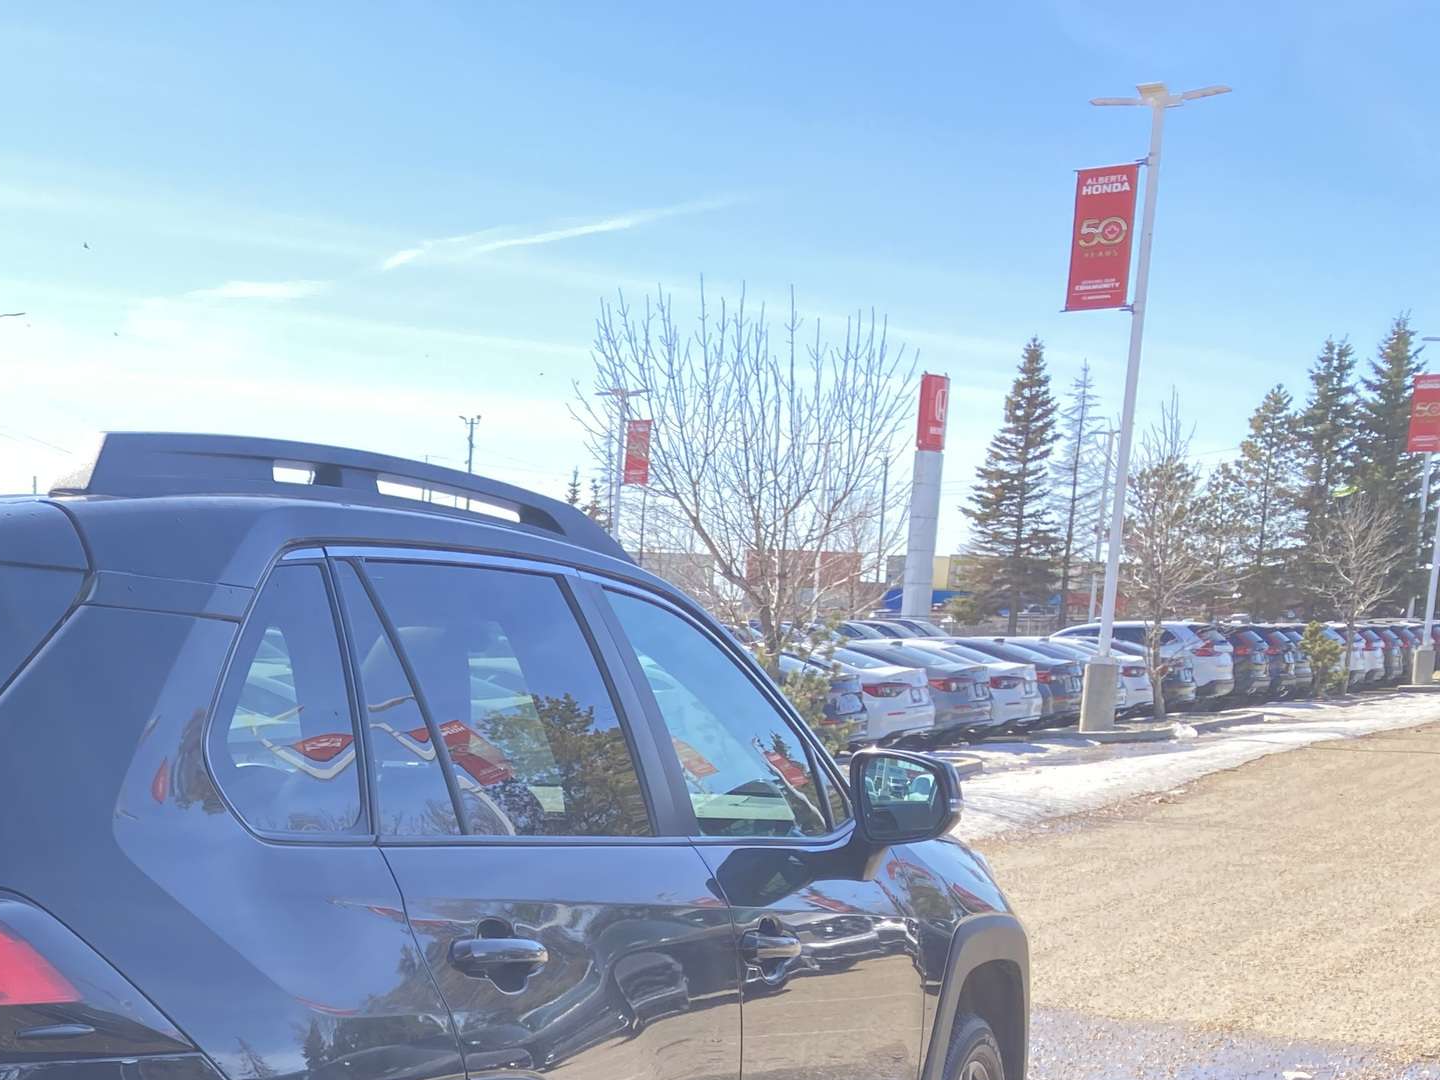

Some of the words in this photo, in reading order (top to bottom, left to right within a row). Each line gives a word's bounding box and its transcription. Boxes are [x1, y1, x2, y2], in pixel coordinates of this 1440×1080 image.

[1086, 174, 1129, 185] ALBERTA
[1082, 182, 1131, 195] HONDA
[1078, 216, 1128, 247] 50
